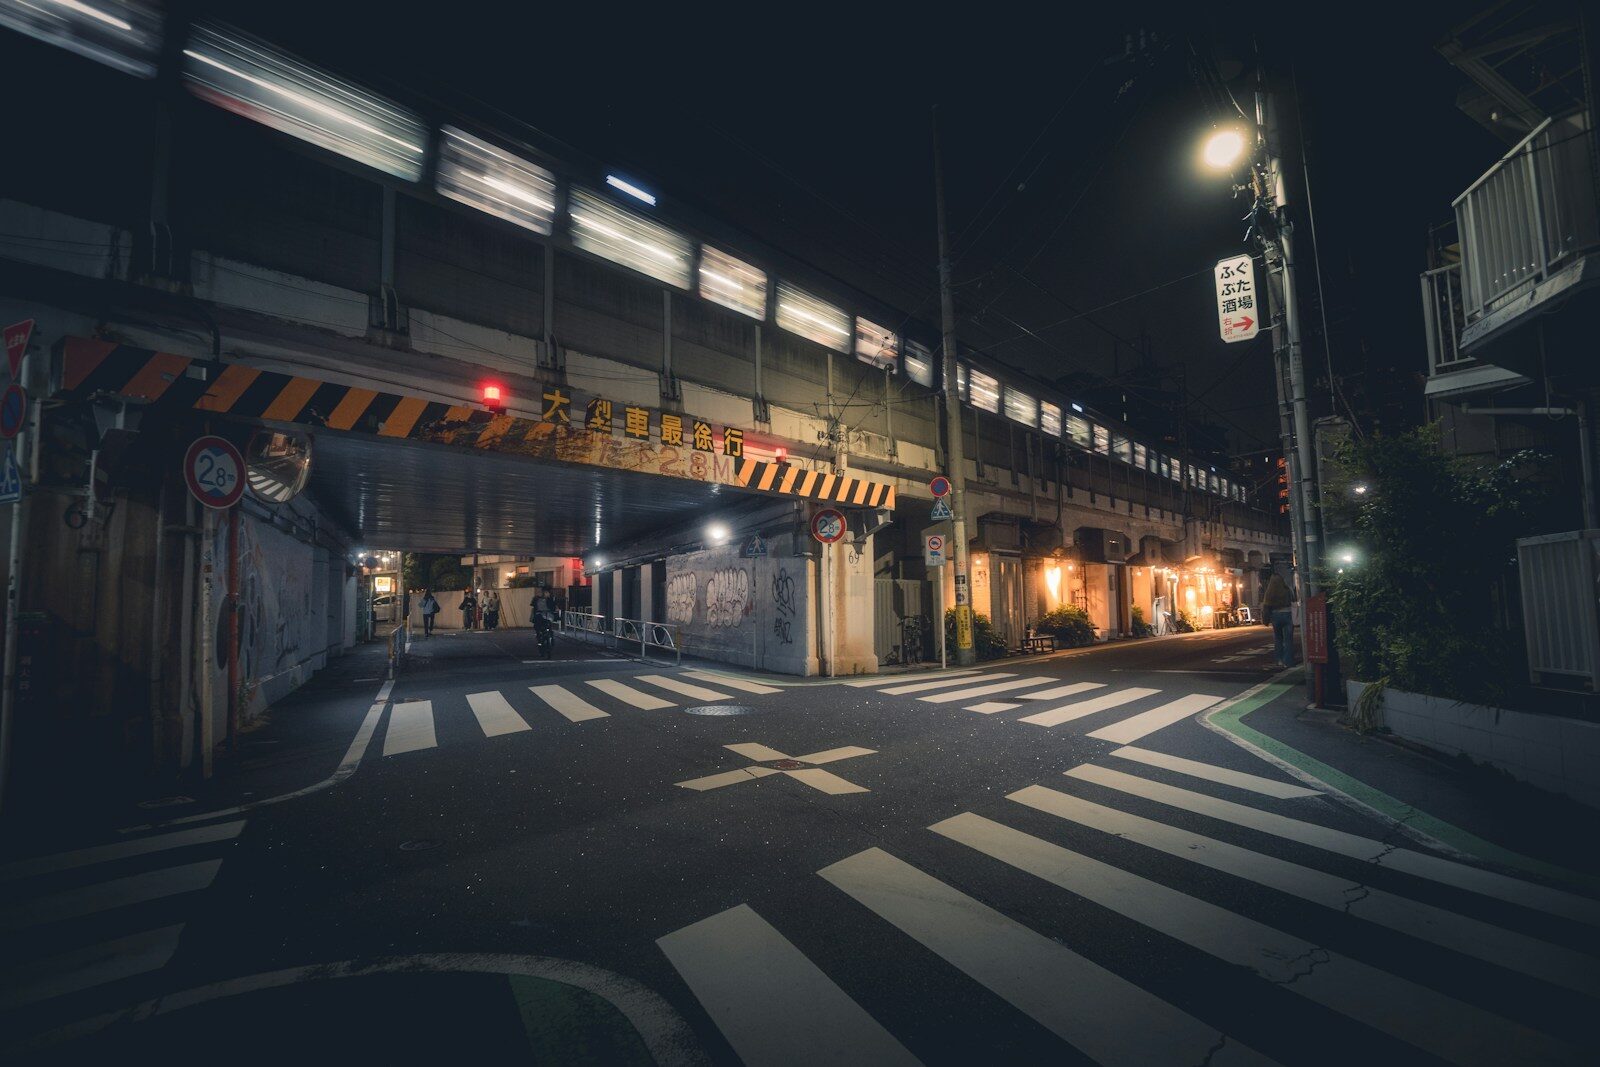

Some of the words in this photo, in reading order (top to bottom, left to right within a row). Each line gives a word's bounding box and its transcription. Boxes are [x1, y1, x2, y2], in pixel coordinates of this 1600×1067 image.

[1220, 262, 1248, 279] ふぐ
[1221, 280, 1251, 295] ぶた
[1222, 295, 1253, 313] 酒場
